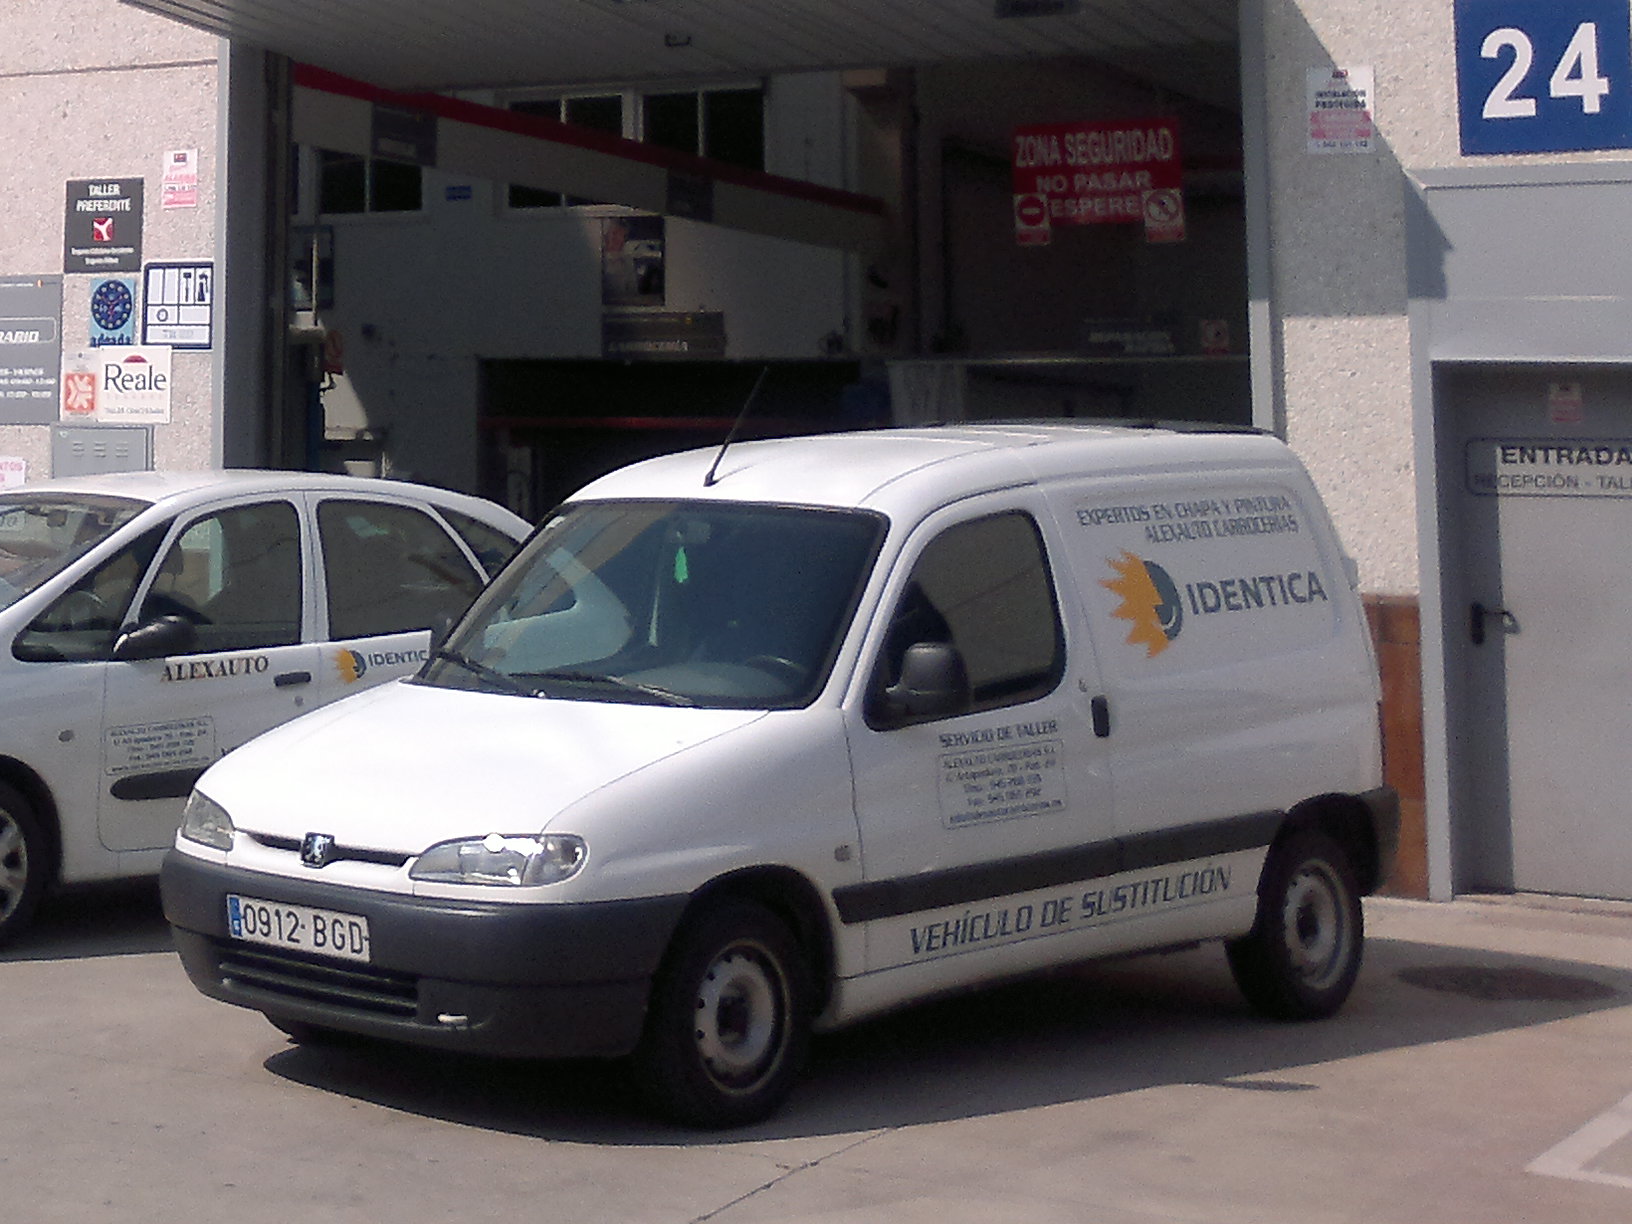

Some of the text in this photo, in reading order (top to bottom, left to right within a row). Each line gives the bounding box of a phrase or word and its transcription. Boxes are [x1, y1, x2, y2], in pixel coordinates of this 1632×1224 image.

[1480, 22, 1609, 119] 24
[1015, 128, 1173, 167] ZONA SEGURIDAD
[89, 184, 121, 196] TALLER
[1036, 170, 1152, 192] NO PASAR
[1050, 196, 1140, 218] ESPERE
[104, 364, 167, 393] Reale
[1501, 445, 1632, 465] ENTRADA
[1076, 495, 1291, 526] EXPERTOS EN CHAPA Y PINTURA
[1185, 571, 1328, 615] IDENTICA
[162, 656, 269, 682] ALEXAUTO
[368, 649, 430, 667] IDENTIC
[939, 729, 994, 748] SERVICIO
[997, 726, 1013, 741] DE
[1040, 897, 1072, 926] DE
[243, 904, 364, 955] 0912 BGD
